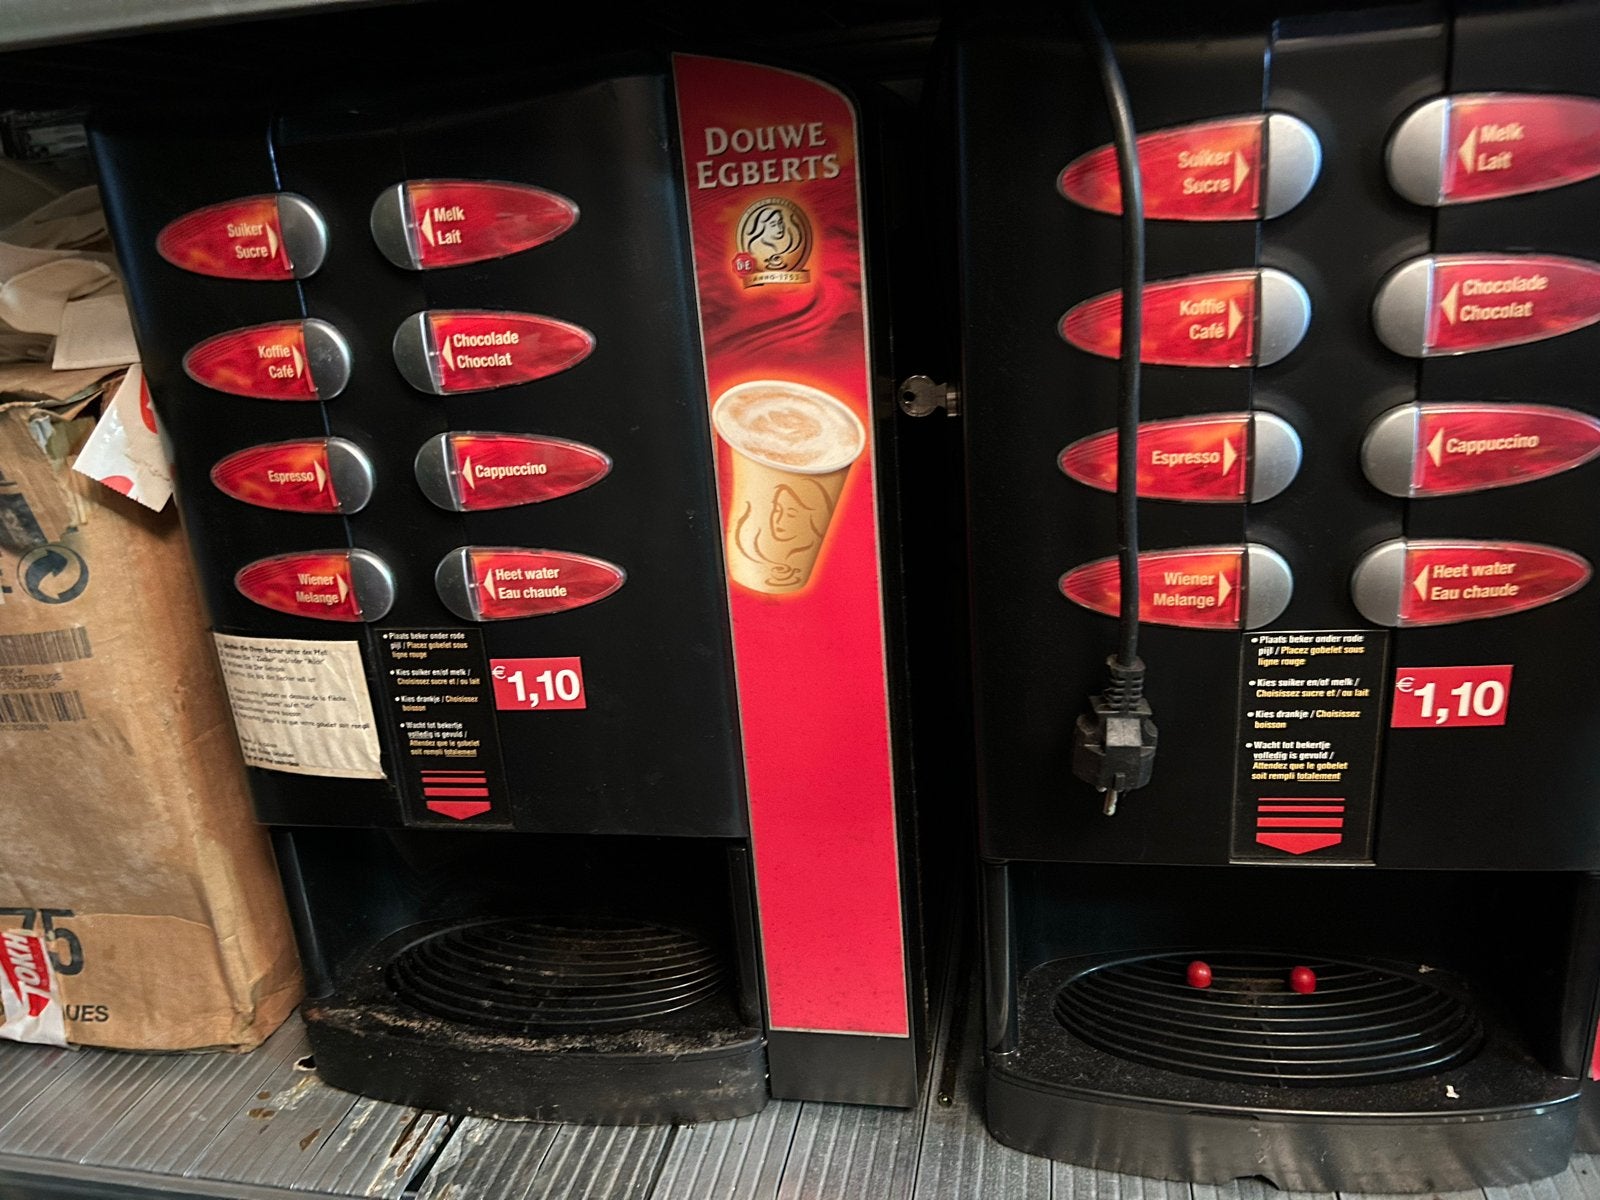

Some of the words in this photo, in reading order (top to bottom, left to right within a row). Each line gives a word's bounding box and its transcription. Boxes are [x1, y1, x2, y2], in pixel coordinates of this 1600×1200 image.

[704, 122, 826, 155] DOUWE
[1480, 123, 1525, 142] Melk
[1178, 150, 1233, 168] Suiker
[1478, 152, 1512, 171] Lait
[697, 154, 839, 189] EGBERTS
[1183, 176, 1230, 194] Sucre
[434, 207, 465, 223] Melk
[227, 223, 263, 237] Suiker
[437, 230, 462, 245] Lait
[235, 244, 268, 259] Sucre
[1463, 274, 1549, 296] Chocolade
[1179, 299, 1226, 315] Koffie
[1460, 301, 1534, 322] Chocolat
[1189, 323, 1224, 339] Café
[453, 331, 519, 348] Chocolade
[258, 345, 290, 358] Koffie
[456, 352, 512, 368] Chocolat
[269, 364, 294, 379] Café
[1446, 433, 1539, 455] Cappuccino
[1152, 450, 1220, 467] Espresso
[268, 470, 315, 484] Espresso
[475, 463, 547, 479] Cappuccino
[496, 567, 523, 581] Heet
[525, 567, 559, 580] water
[1433, 564, 1468, 578] Heet
[1472, 562, 1516, 576] water
[298, 573, 334, 586] Wiener
[1164, 573, 1215, 585] Wiener
[296, 592, 339, 606] Melange
[499, 586, 520, 599] Eau
[523, 585, 566, 598] chaude
[1431, 587, 1459, 600] Eau
[1463, 584, 1519, 598] chaude
[1153, 593, 1214, 608] Melange
[1260, 635, 1287, 643] Plaats
[1289, 635, 1313, 643] beker
[1281, 646, 1308, 654] Placez
[1310, 646, 1342, 655] gobelet
[1344, 646, 1364, 654] sous
[1258, 657, 1279, 666] ligne
[1281, 658, 1305, 666] rouge
[1258, 679, 1275, 687] Kies
[1278, 679, 1305, 687] suiker
[1307, 679, 1329, 687] en/of
[1331, 678, 1353, 686] melk
[1256, 689, 1299, 697] Choisissez
[1255, 710, 1274, 718] Kies
[1276, 710, 1308, 719] drankje
[438, 722, 462, 730] bekertje
[1254, 741, 1280, 749] Wacht
[1296, 741, 1330, 750] bekertje
[1254, 752, 1287, 760] volledig
[1299, 752, 1327, 760] gevuld
[1253, 762, 1287, 770] Attendez
[1317, 762, 1347, 770] gobelet
[1269, 772, 1295, 780] rempli
[1297, 772, 1340, 780] totalement
